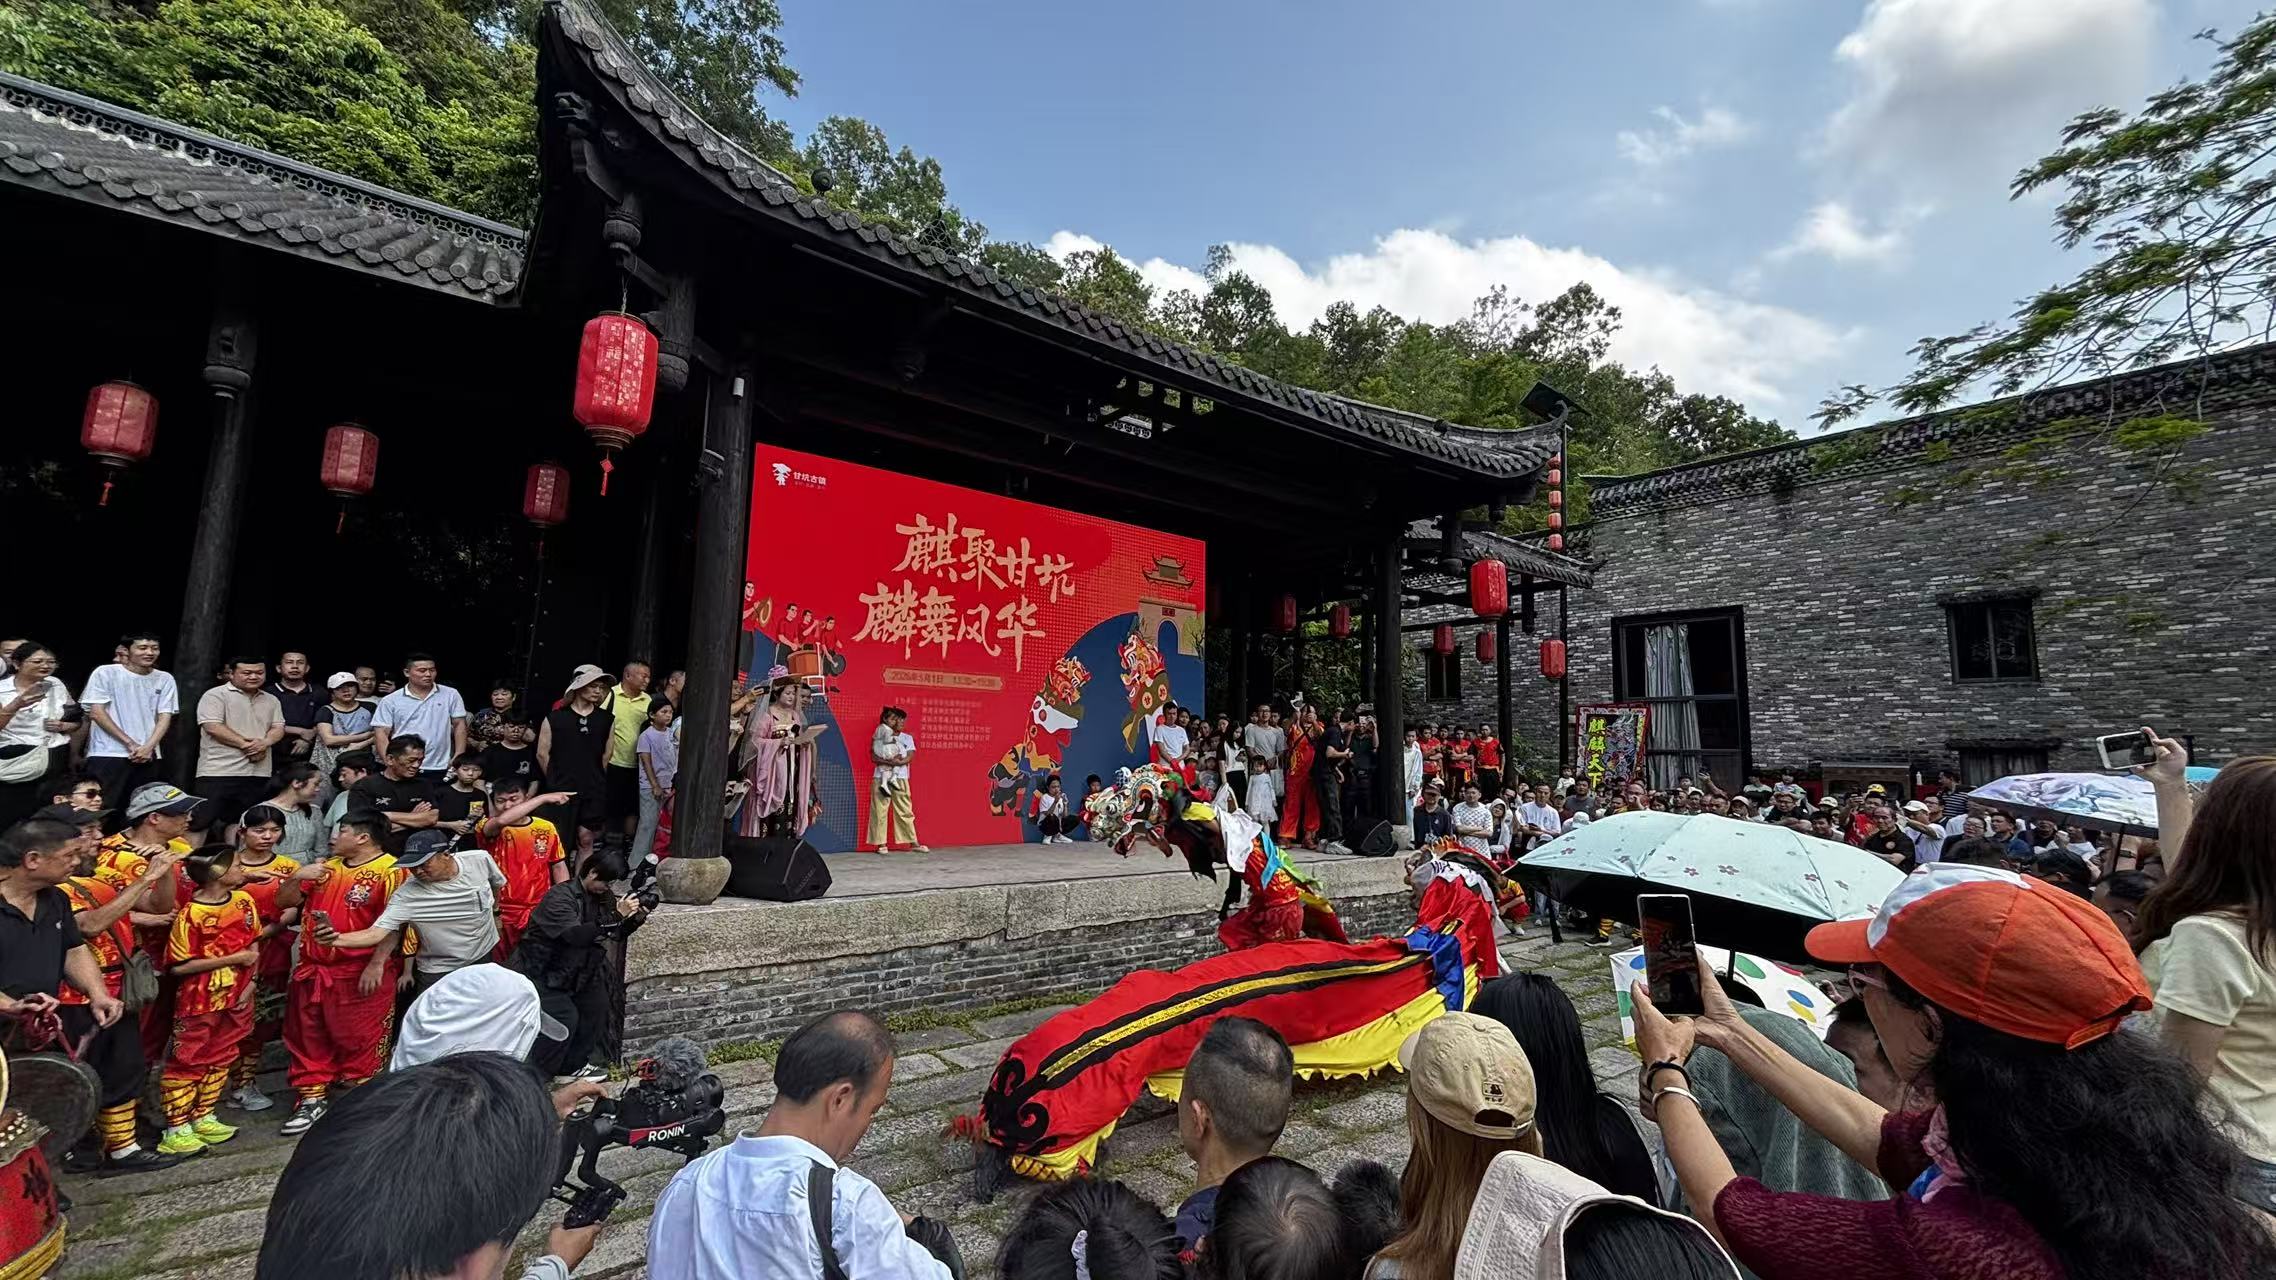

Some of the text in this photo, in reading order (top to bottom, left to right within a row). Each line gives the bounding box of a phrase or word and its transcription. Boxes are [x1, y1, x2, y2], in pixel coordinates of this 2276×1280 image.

[891, 512, 1075, 604] 麒聚甘坑
[850, 578, 1046, 672] 麟舞风华
[1587, 718, 1606, 789] 麒麟天下
[648, 1124, 686, 1142] RONIN
